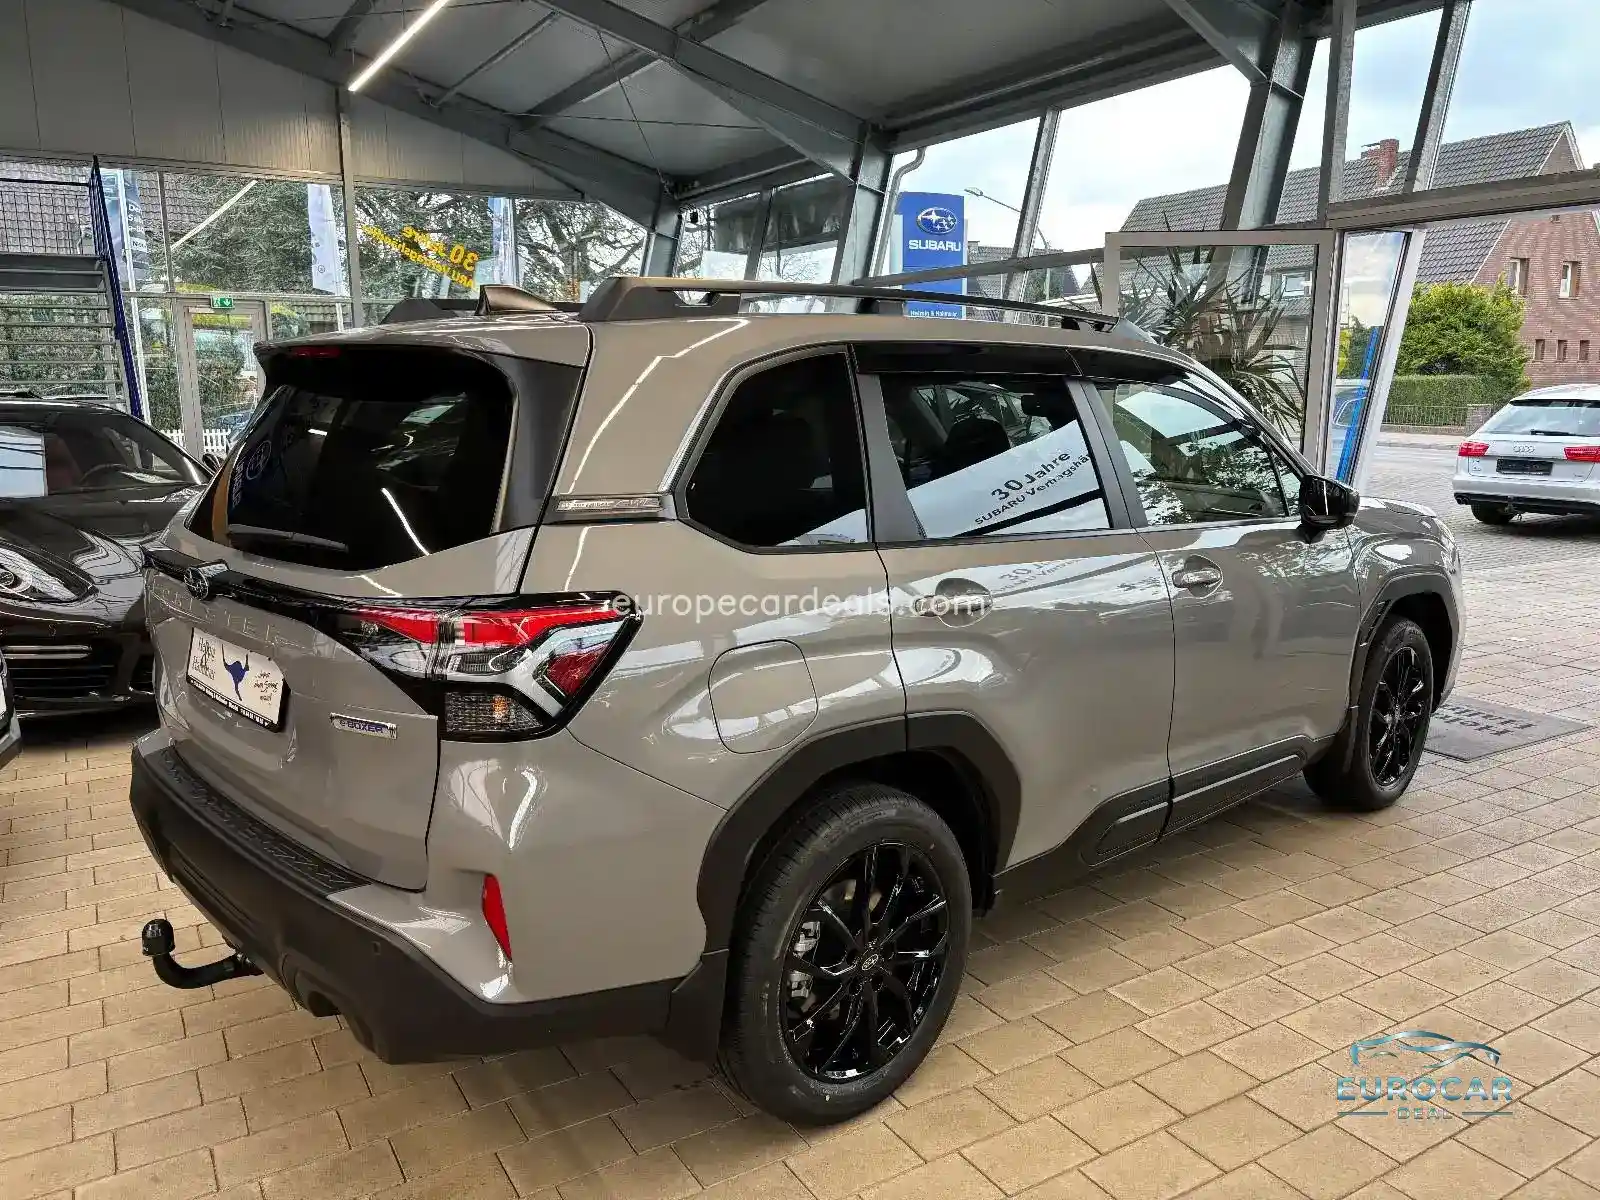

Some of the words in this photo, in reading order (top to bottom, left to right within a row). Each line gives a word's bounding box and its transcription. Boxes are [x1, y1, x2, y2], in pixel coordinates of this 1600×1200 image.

[908, 239, 961, 252] SUBARU
[991, 479, 1023, 501] 30
[1024, 452, 1071, 484] Jahre
[974, 495, 1026, 525] SUBARU
